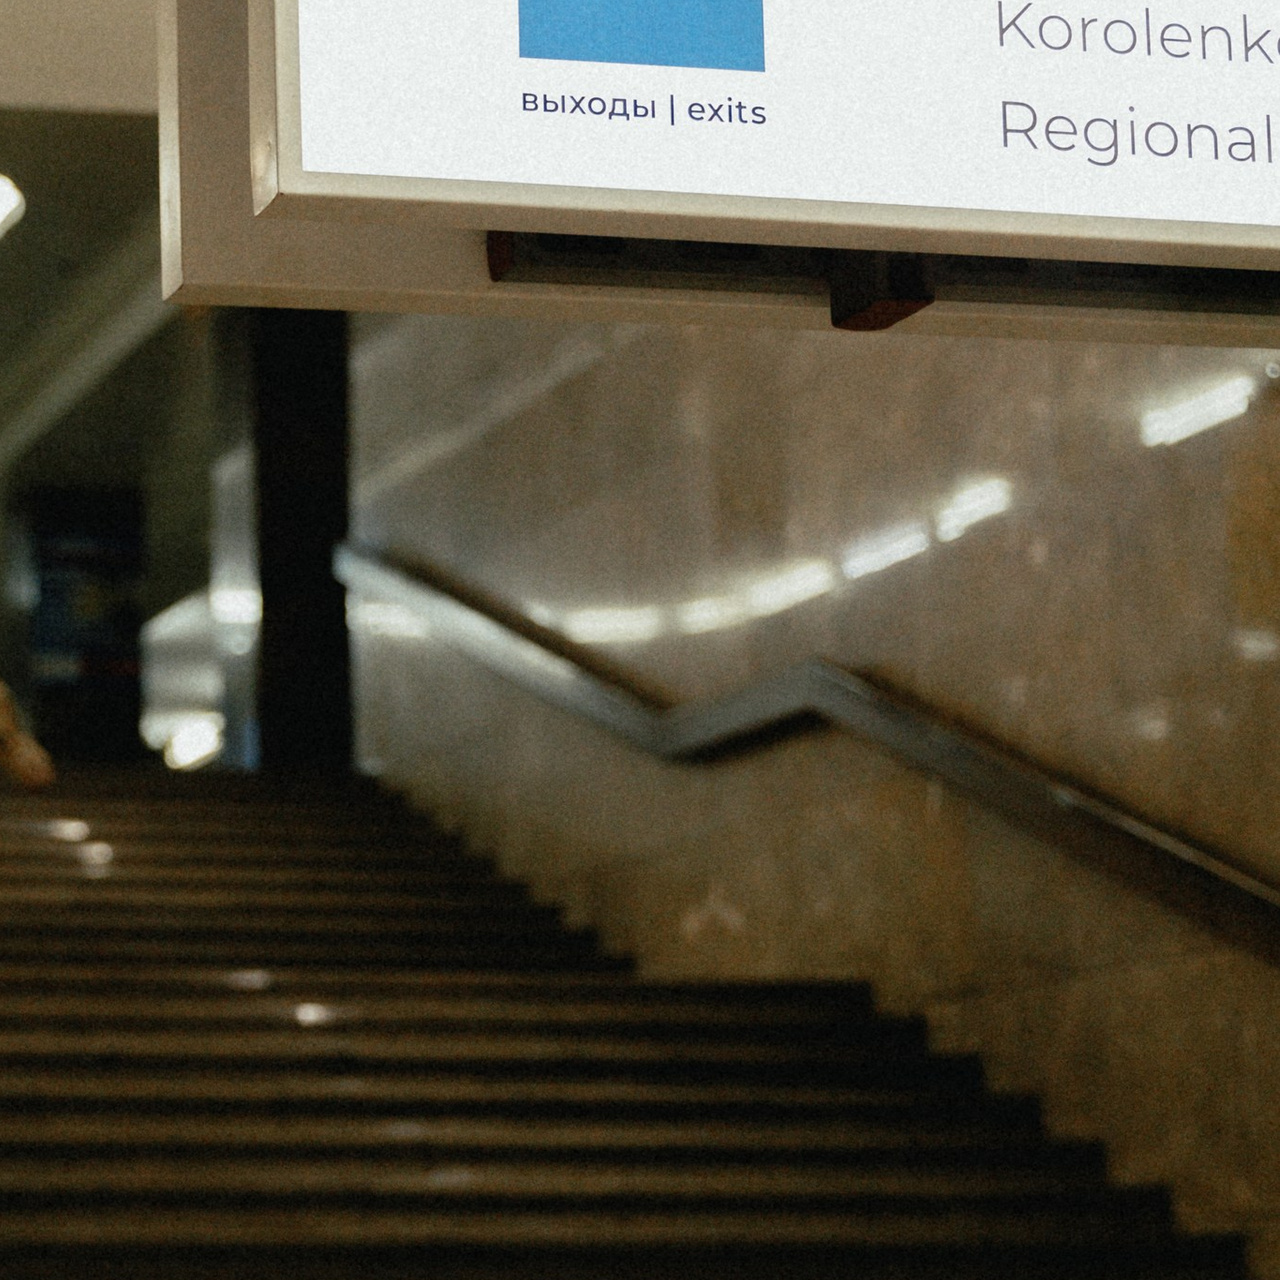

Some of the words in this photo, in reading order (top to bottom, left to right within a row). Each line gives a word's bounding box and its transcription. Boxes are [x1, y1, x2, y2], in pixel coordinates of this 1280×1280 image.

[997, 0, 1280, 64] Korolenk
[521, 92, 656, 121] выходы
[687, 97, 767, 126] exits
[1001, 100, 1273, 168] Regional
